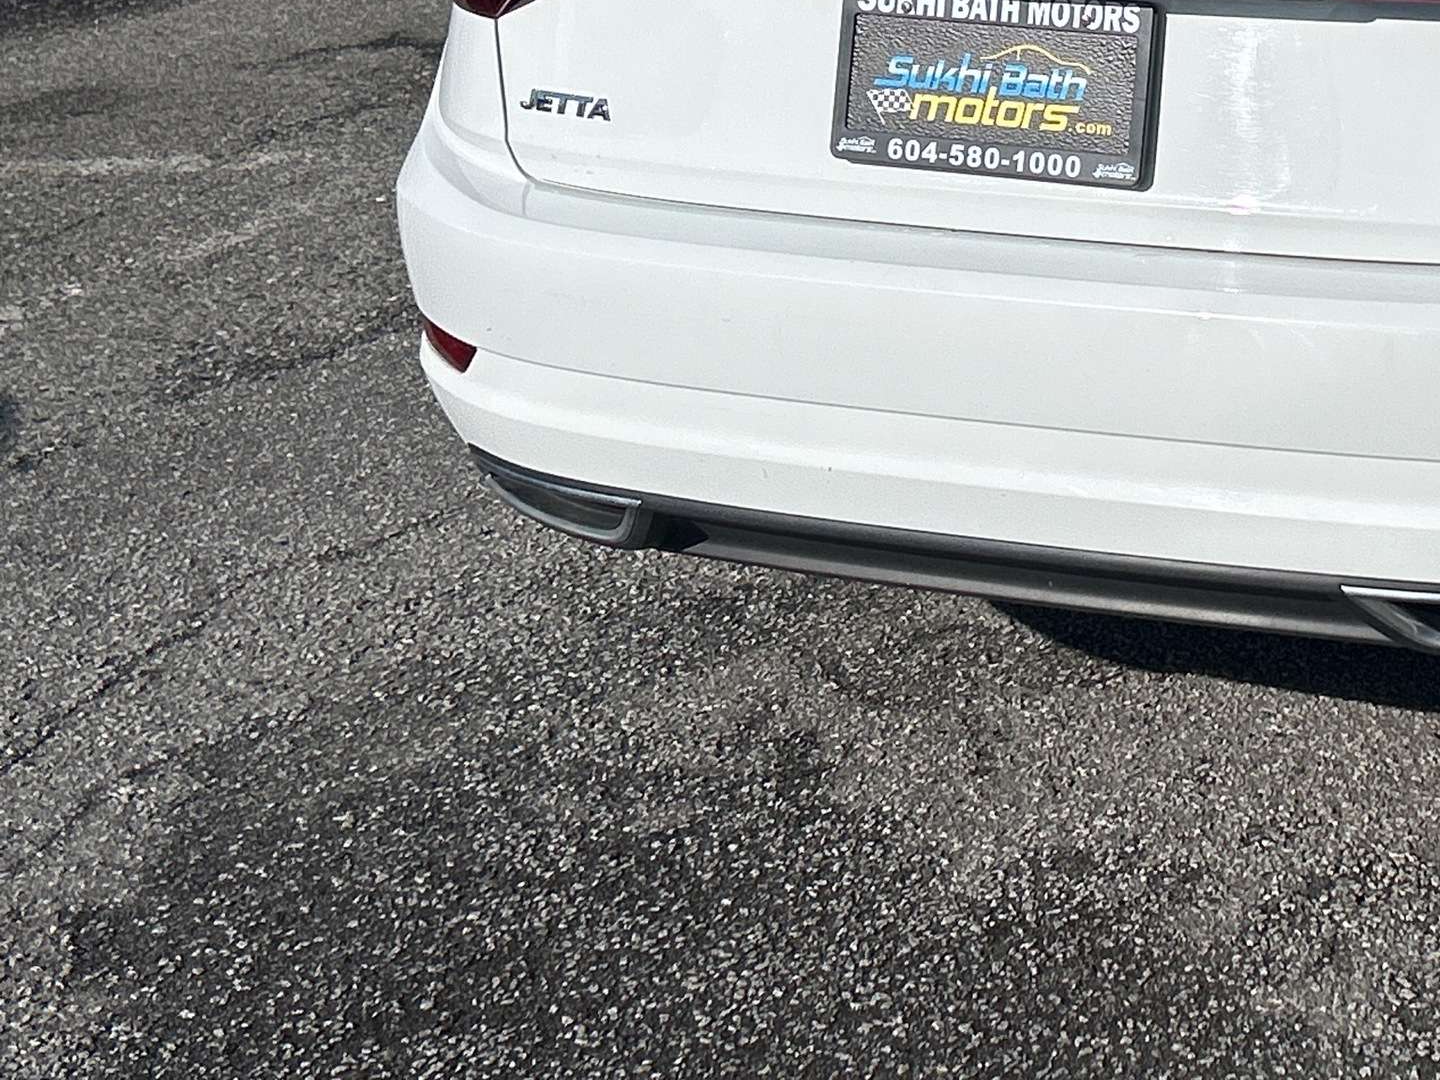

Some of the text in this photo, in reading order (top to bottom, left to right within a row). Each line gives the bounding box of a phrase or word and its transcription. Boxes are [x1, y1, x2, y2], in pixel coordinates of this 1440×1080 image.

[873, 52, 1088, 102] Sukhi Bath
[520, 88, 611, 121] JETTA
[886, 137, 1081, 179] 604-580-1000
